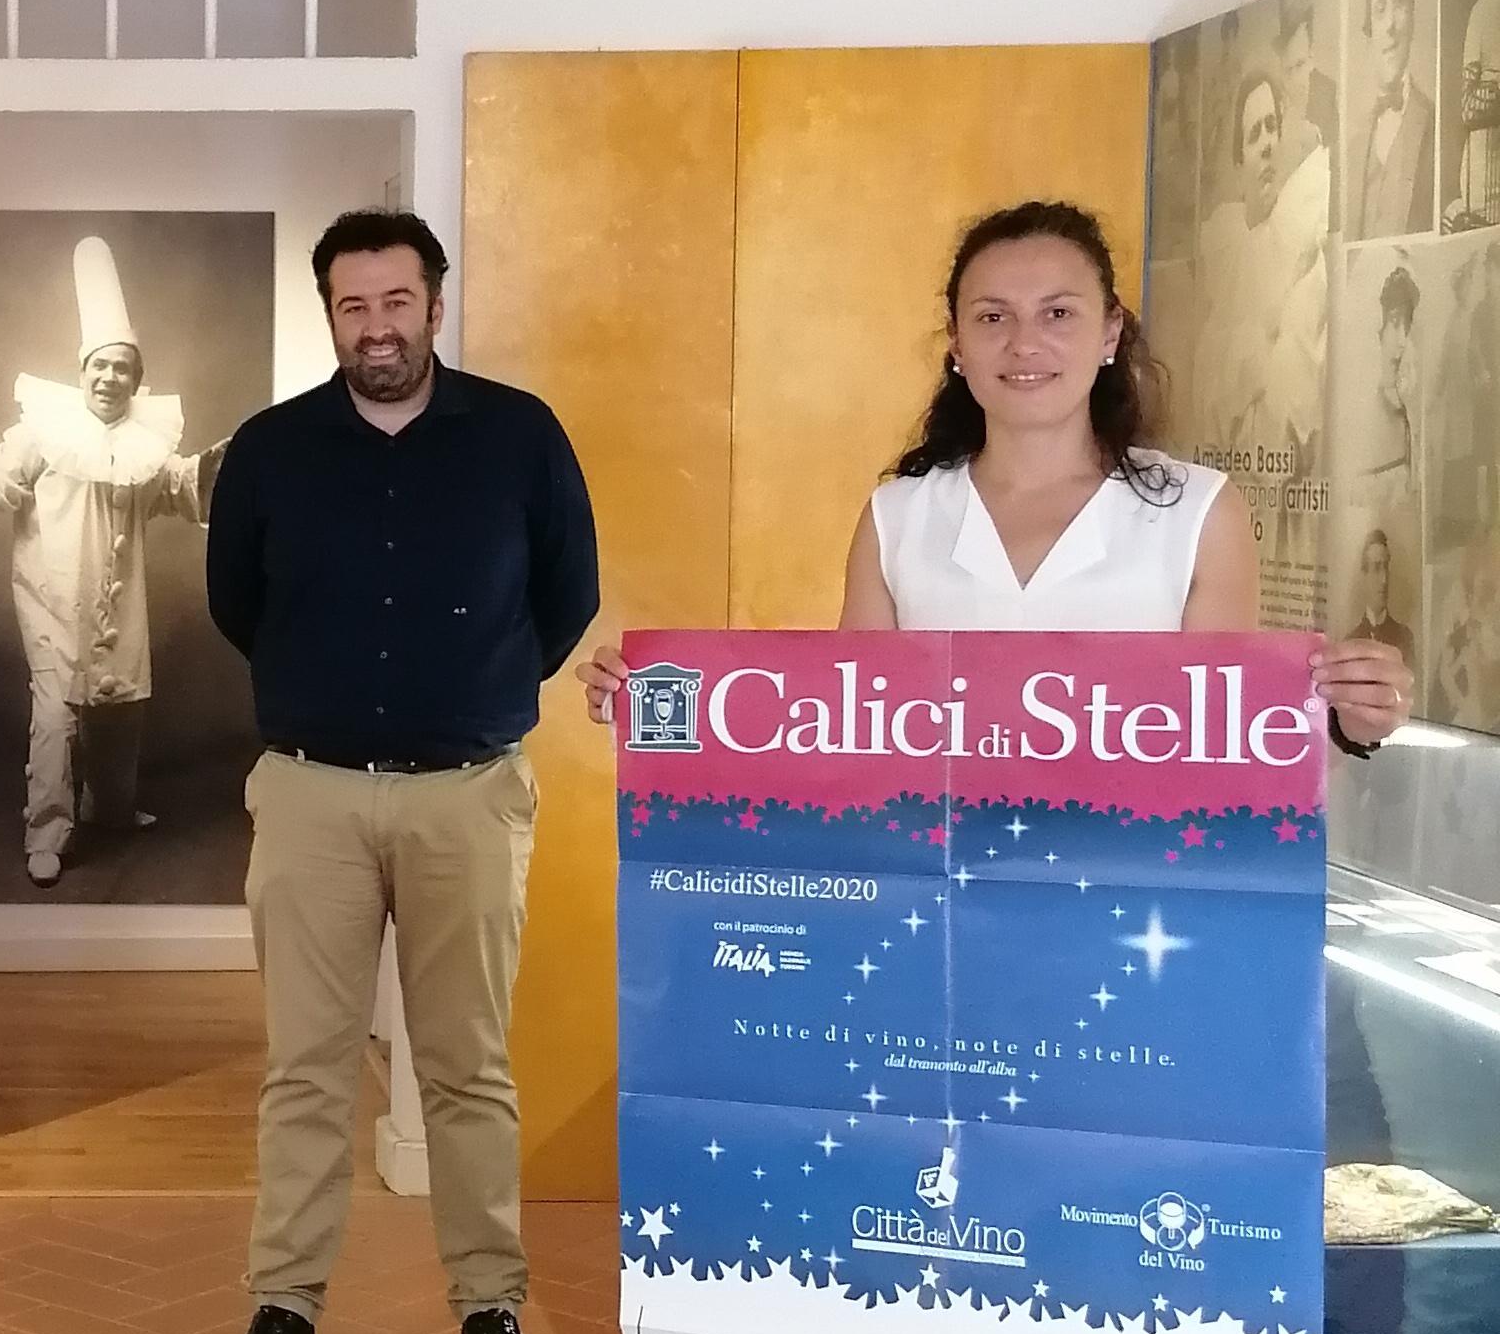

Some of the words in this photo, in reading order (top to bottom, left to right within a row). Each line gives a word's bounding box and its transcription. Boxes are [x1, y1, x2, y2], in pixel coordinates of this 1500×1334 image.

[1193, 444, 1251, 473] Amedeo
[1257, 444, 1295, 474] Bassi
[1237, 478, 1282, 508] randi
[1286, 480, 1329, 511] artisti
[707, 660, 971, 759] Calici
[978, 725, 1012, 758] di
[1020, 664, 1311, 767] Stelle
[649, 869, 879, 902] #CalicidiStelle2020
[713, 921, 732, 933] con
[734, 921, 741, 933] il
[743, 922, 794, 936] patrocinio
[796, 923, 807, 936] di
[733, 1018, 811, 1040] Notte
[825, 1024, 851, 1044] di
[865, 1029, 940, 1051] vino,
[954, 1037, 1019, 1056] note
[1034, 1039, 1062, 1058] di
[1078, 1044, 1177, 1067] stelle.
[884, 1053, 906, 1068] dal
[907, 1056, 966, 1073] tramonto
[968, 1059, 1018, 1077] all'alba
[852, 1205, 925, 1243] Città
[926, 1228, 951, 1245] del
[949, 1214, 1026, 1255] Vino
[1060, 1203, 1138, 1227] Movimento
[1207, 1218, 1283, 1241] Turismo
[1138, 1250, 1162, 1268] del
[1168, 1253, 1205, 1272] Vino
